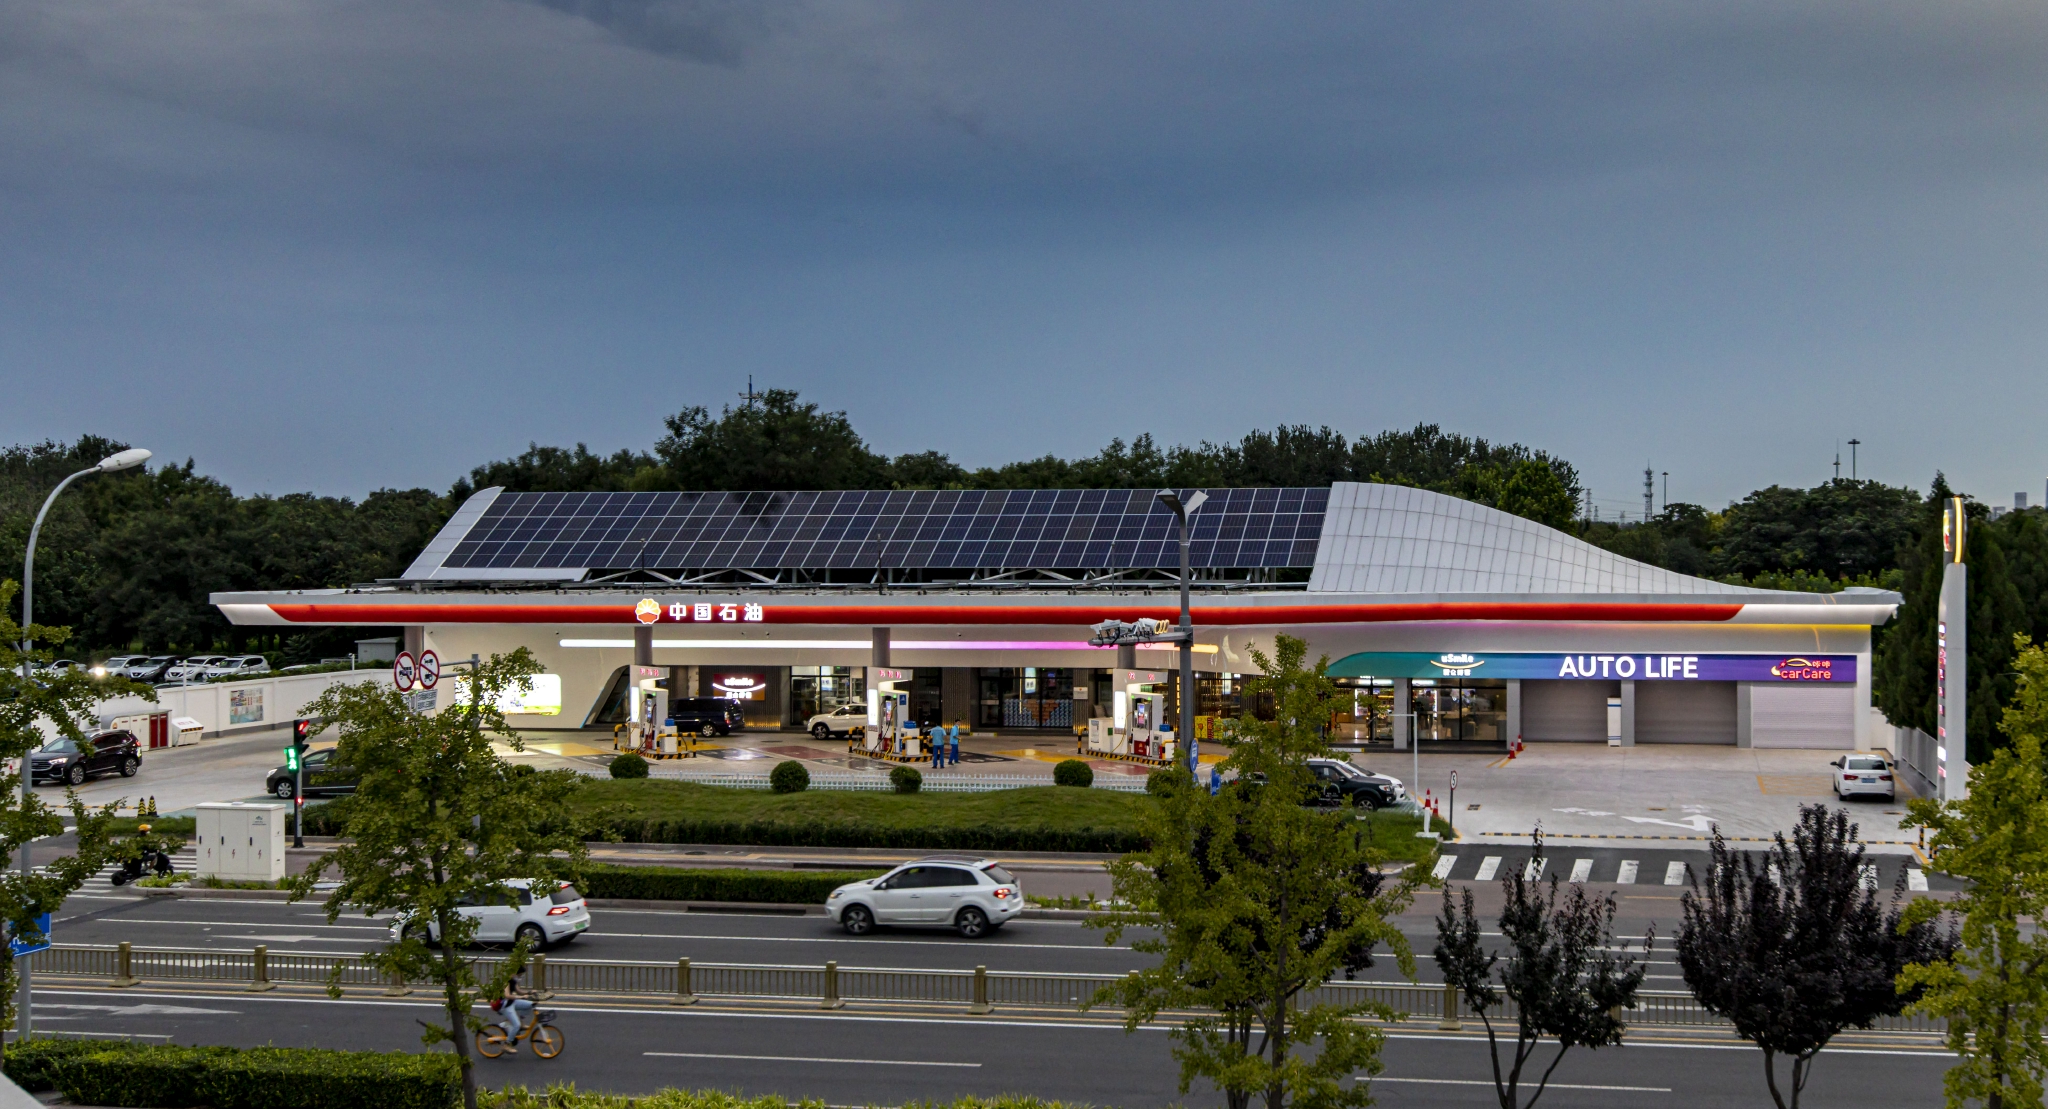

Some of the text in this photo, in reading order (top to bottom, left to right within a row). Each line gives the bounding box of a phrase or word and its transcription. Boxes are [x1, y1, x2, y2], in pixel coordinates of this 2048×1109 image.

[669, 602, 763, 621] 中国石油
[1441, 654, 1474, 663] uSmile
[1559, 656, 1699, 678] AUTO LIFE
[1781, 668, 1831, 679] carCare
